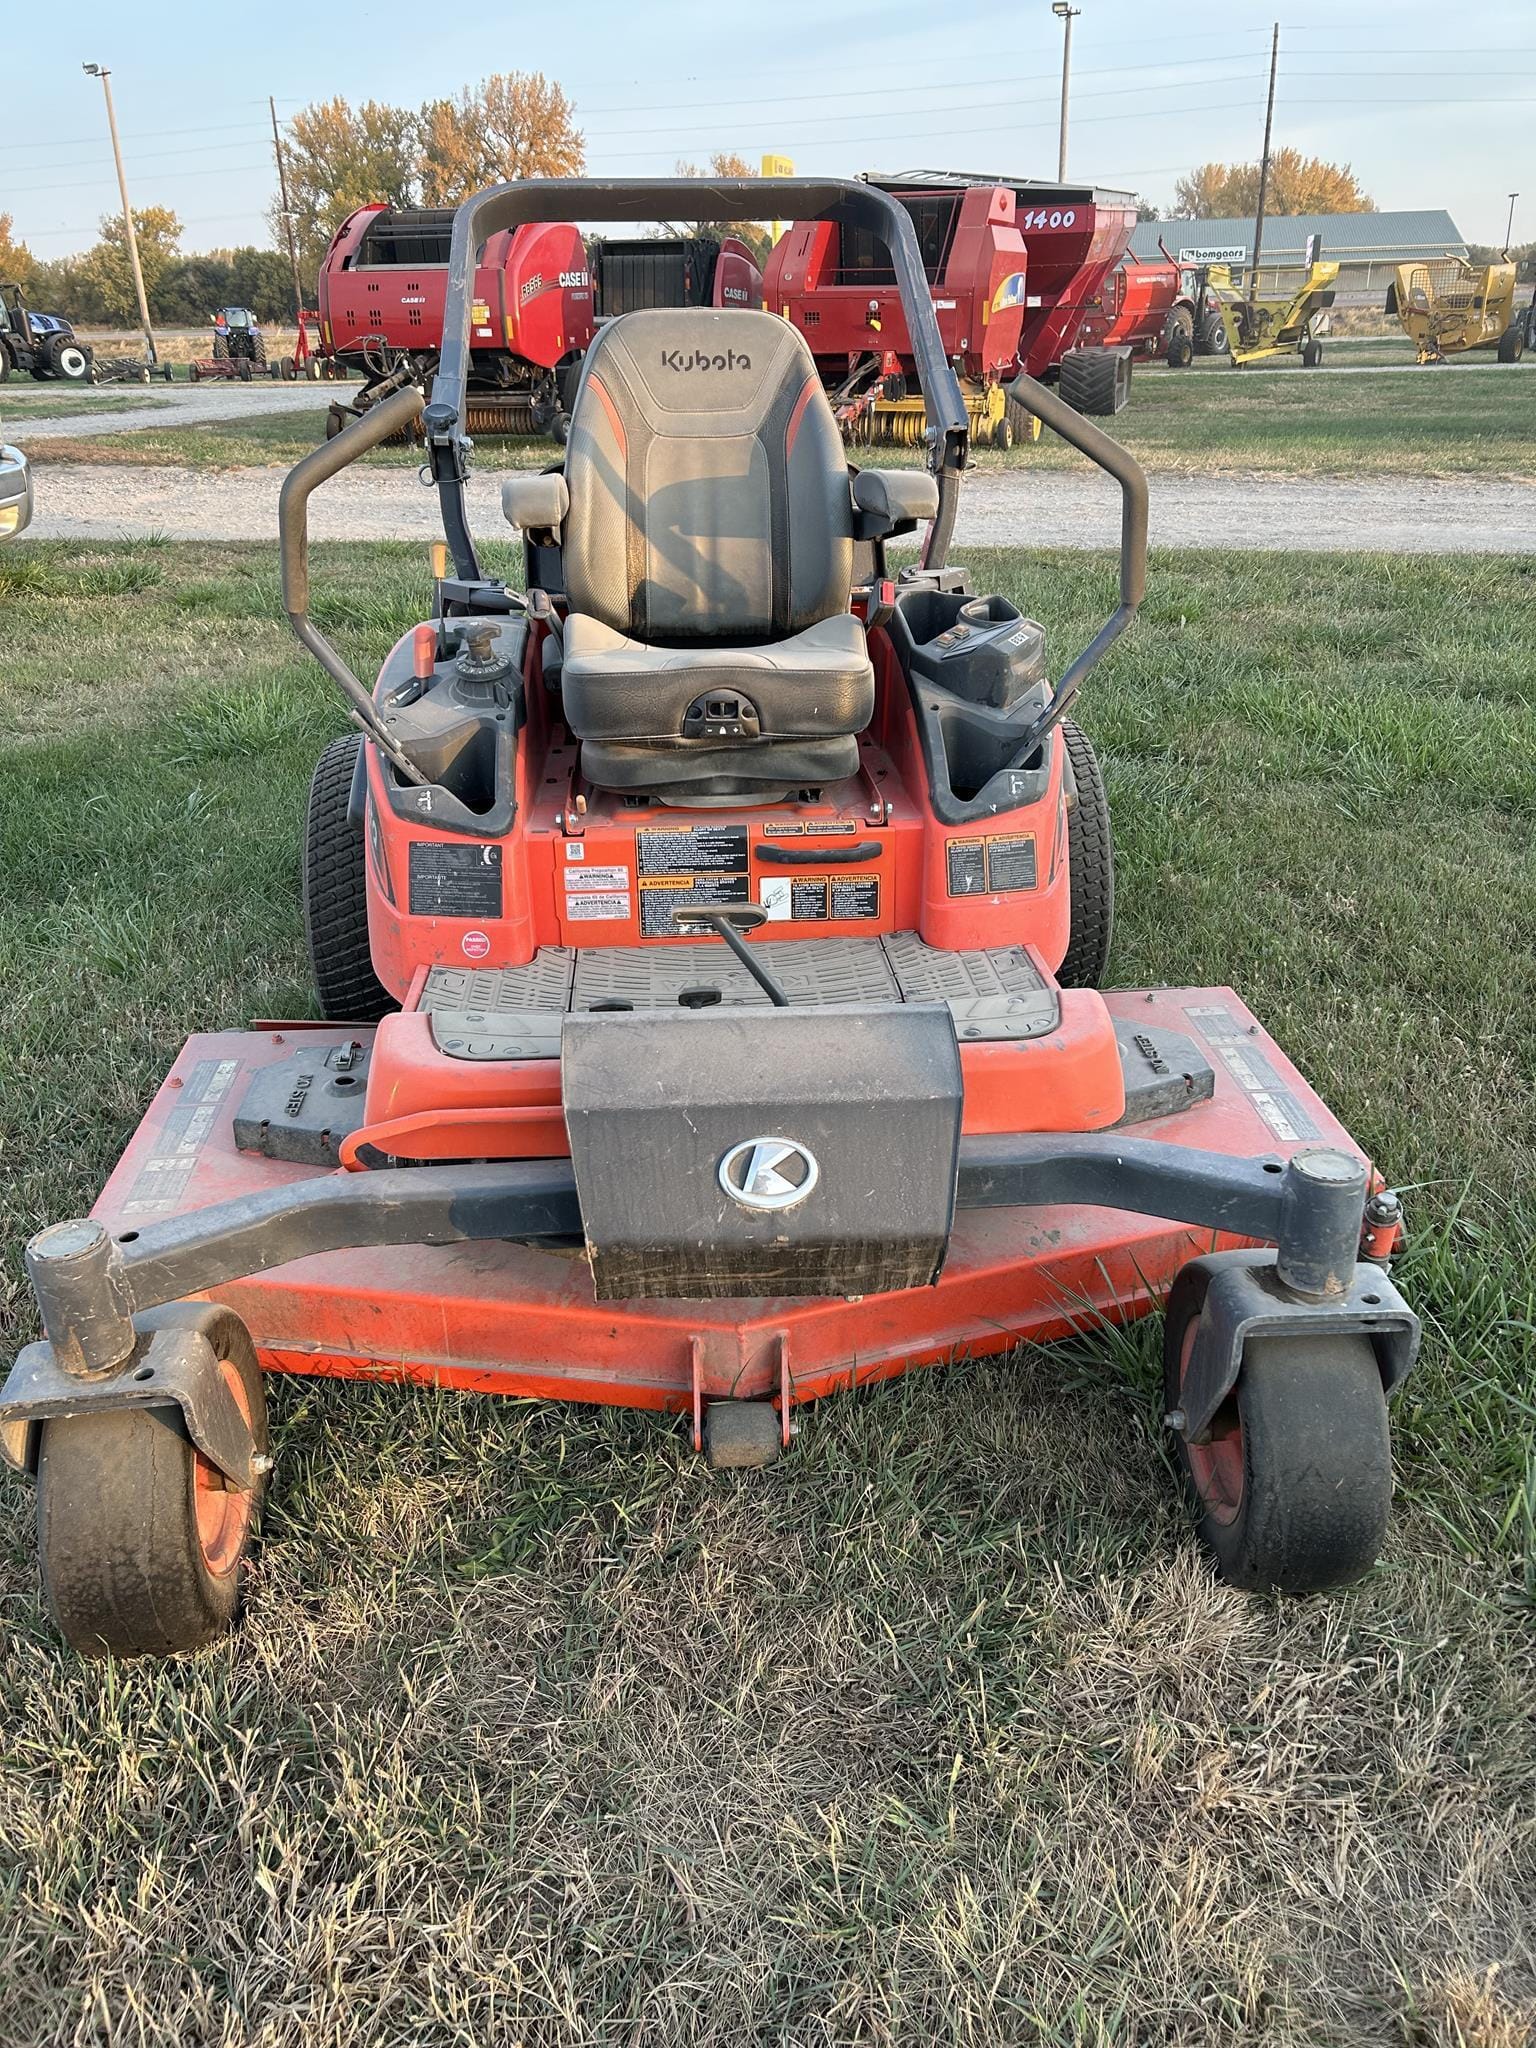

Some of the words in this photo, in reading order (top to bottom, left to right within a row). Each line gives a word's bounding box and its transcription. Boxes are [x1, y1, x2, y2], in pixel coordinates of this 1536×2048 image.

[1024, 210, 1075, 229] 1400
[1196, 250, 1243, 260] bomgaars
[559, 272, 581, 288] CASE
[724, 287, 741, 300] CASE
[661, 349, 752, 372] Kubota
[295, 1073, 314, 1089] NO
[283, 1089, 308, 1118] STEP
